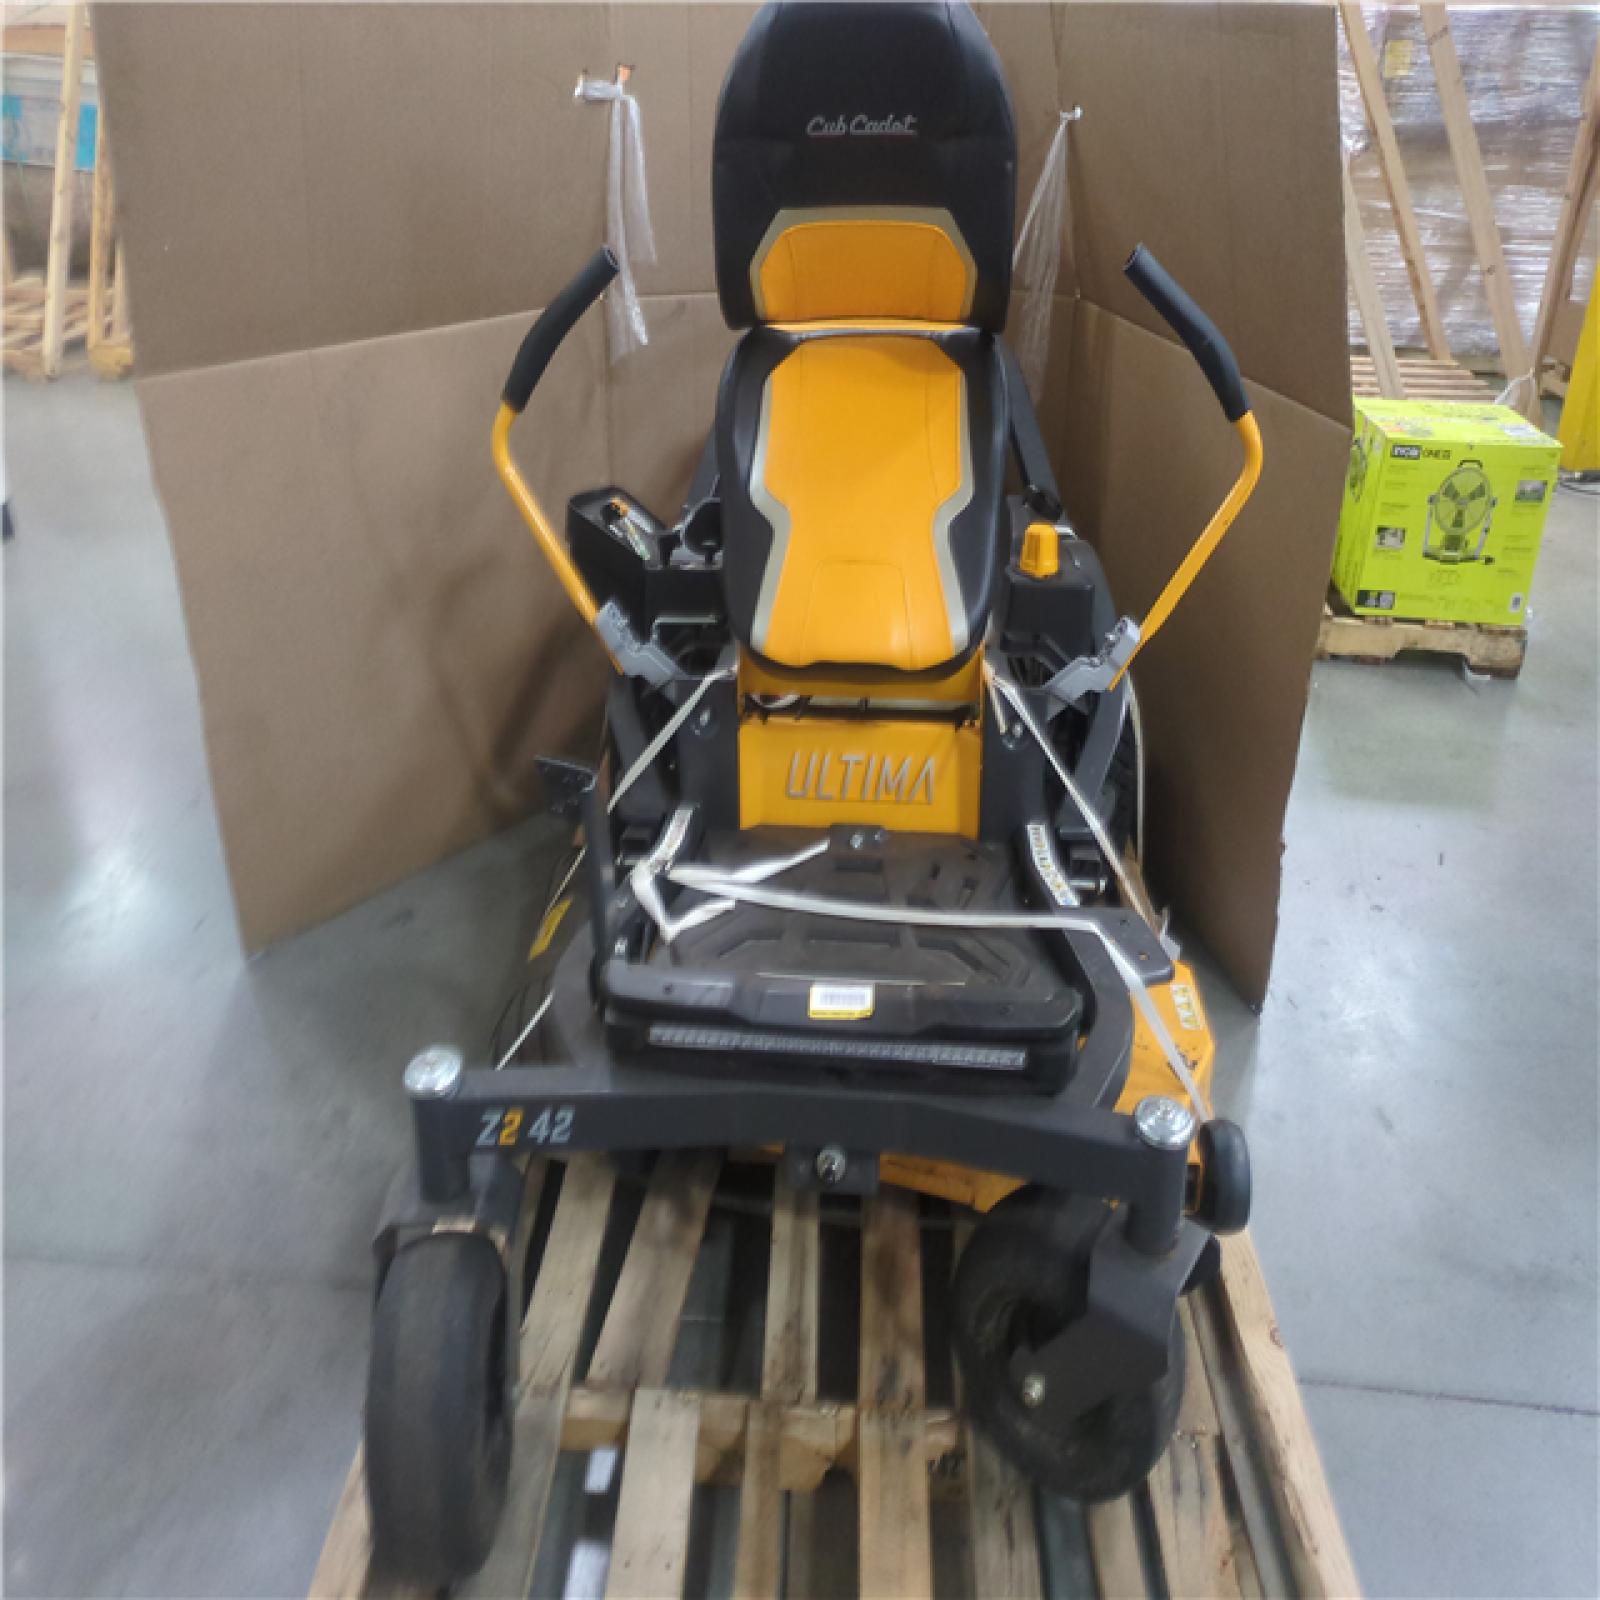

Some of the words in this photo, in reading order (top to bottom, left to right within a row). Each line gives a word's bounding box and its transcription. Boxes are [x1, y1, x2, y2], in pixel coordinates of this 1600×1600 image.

[807, 114, 846, 136] Cub
[850, 113, 918, 136] Cadet
[786, 751, 934, 805] ULTIMA
[475, 1106, 523, 1146] Z2
[527, 1105, 576, 1144] 42
